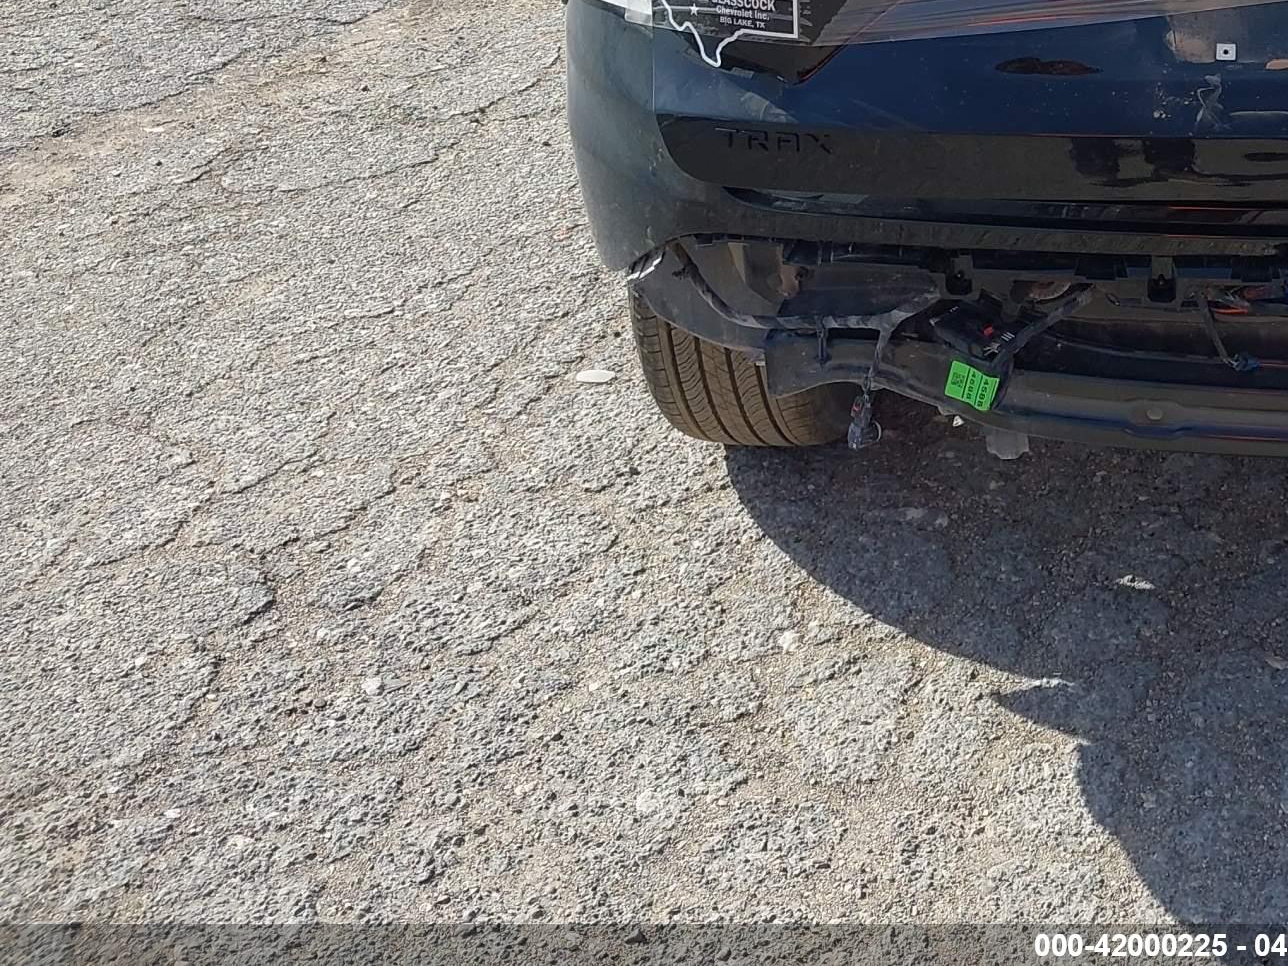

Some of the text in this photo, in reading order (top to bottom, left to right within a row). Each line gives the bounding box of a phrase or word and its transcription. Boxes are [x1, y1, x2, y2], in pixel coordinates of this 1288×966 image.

[716, 6, 753, 19] Chevrolet
[719, 16, 766, 29] BIG LAKE, TX
[715, 127, 833, 155] TRAX
